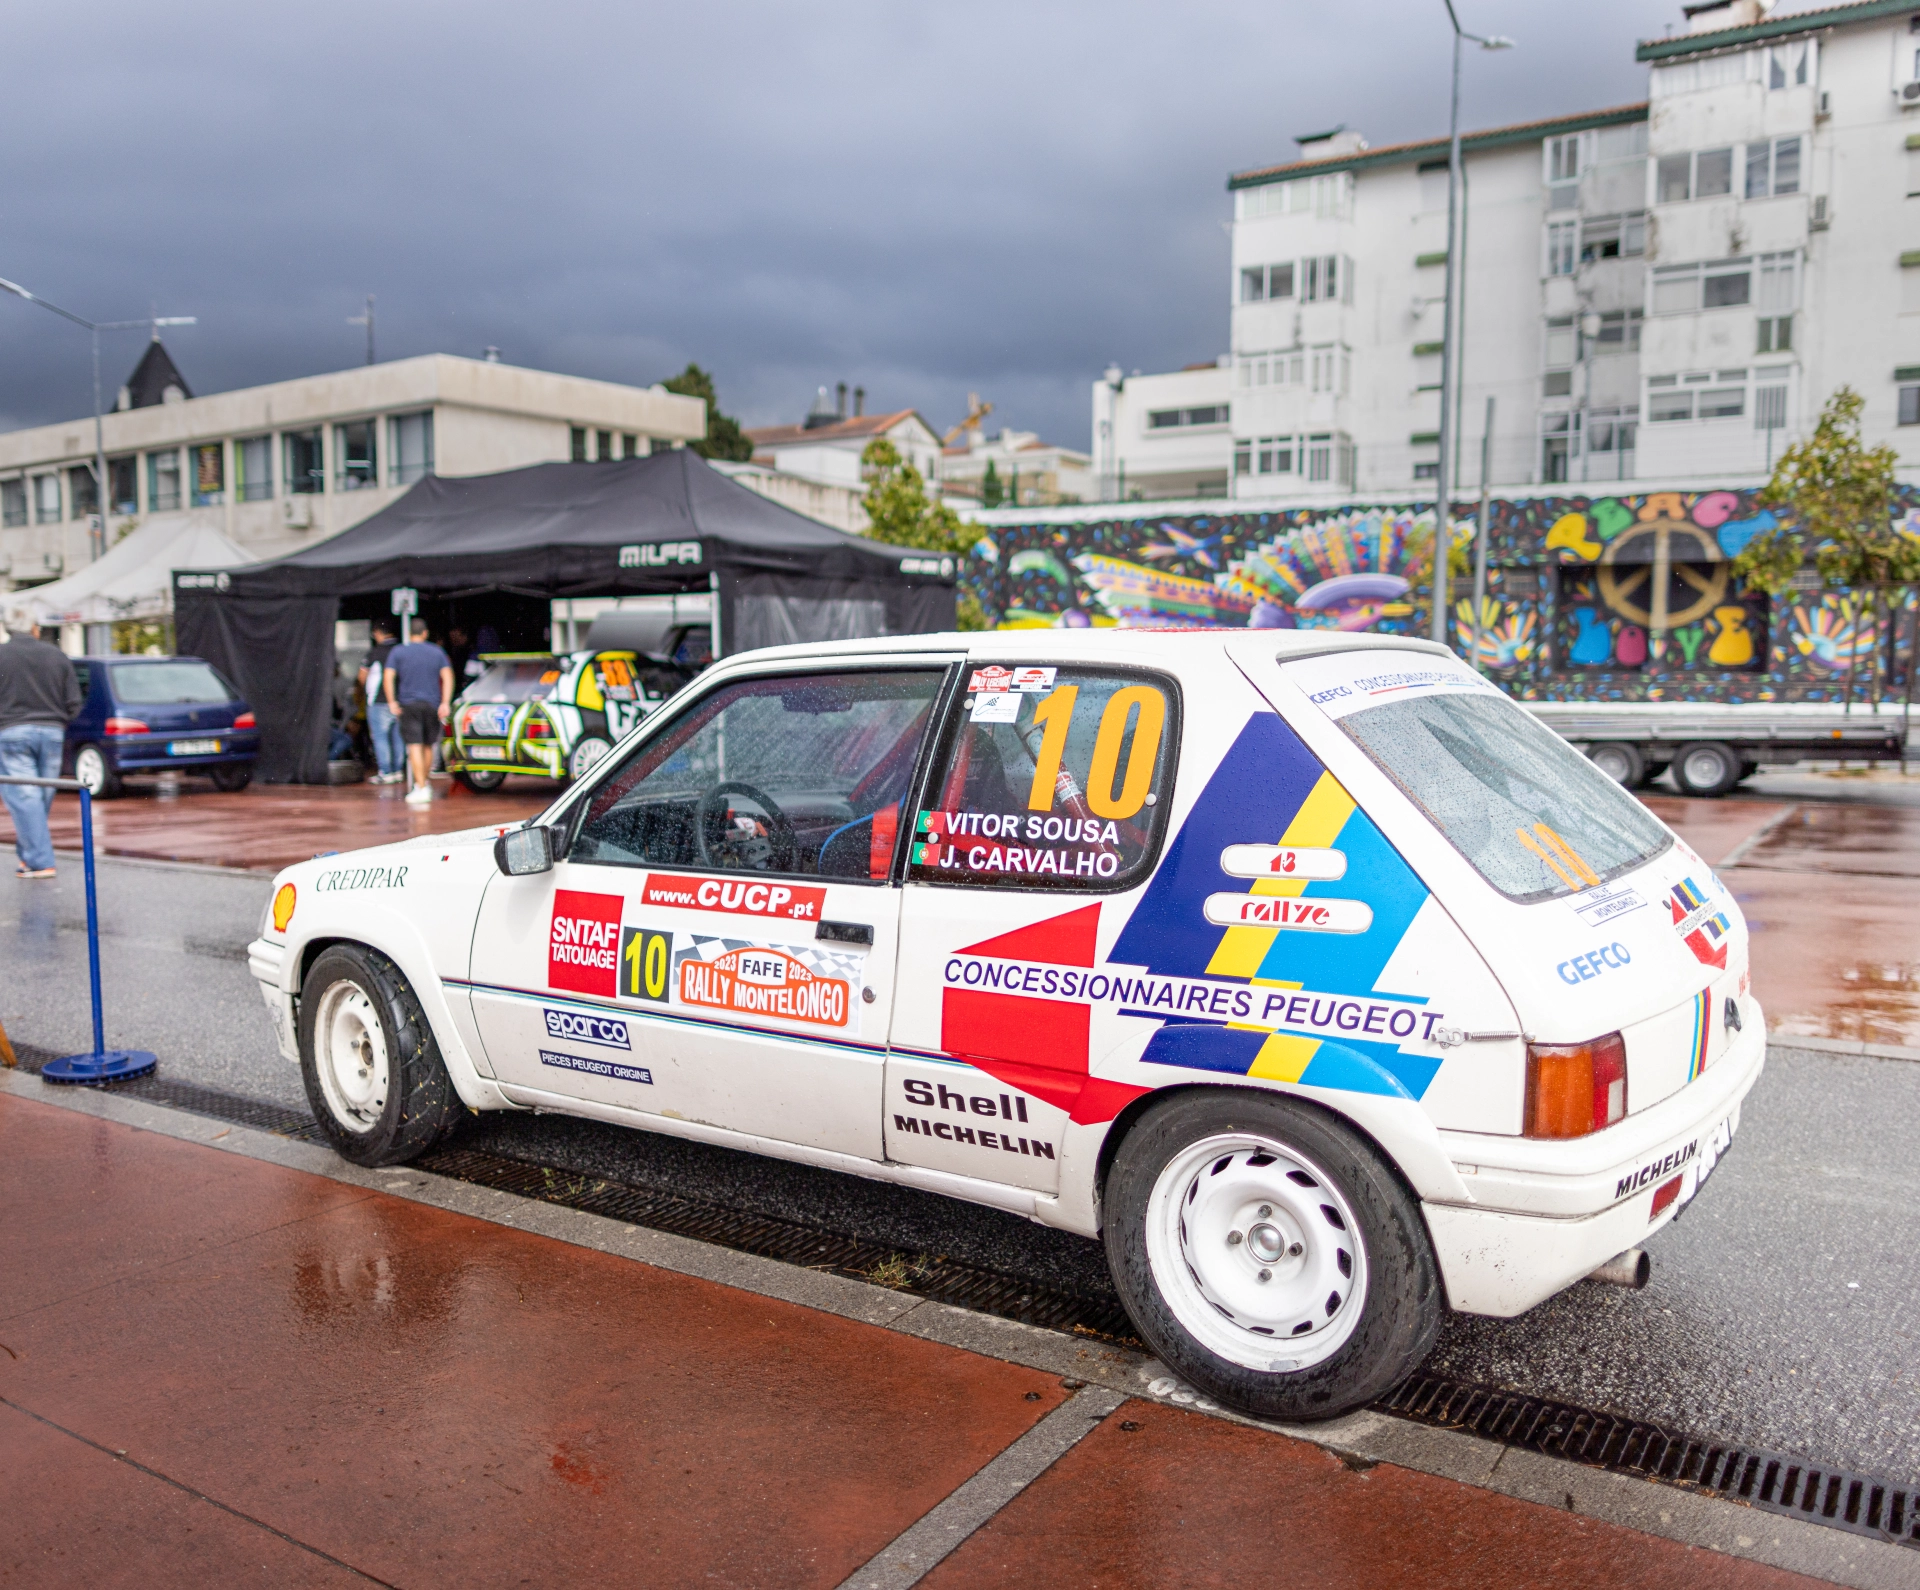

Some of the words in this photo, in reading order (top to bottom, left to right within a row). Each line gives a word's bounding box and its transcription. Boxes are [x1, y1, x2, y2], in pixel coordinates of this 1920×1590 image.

[619, 541, 702, 568] MILFA
[1569, 605, 1754, 666] LOVE
[1310, 686, 1353, 704] GEFCO
[1028, 685, 1165, 820] 10
[945, 812, 1019, 838] VITOR
[1026, 816, 1120, 844] SOUSA
[940, 846, 961, 869] J.
[968, 846, 1118, 876] CARVALHO
[1515, 823, 1601, 892] 10
[316, 866, 409, 892] CREDIPAR
[649, 880, 814, 919] www.CUCP.pt
[1240, 901, 1330, 925] rallye
[552, 916, 619, 948] SNTAF
[551, 943, 616, 970] TATOUAGE
[625, 932, 667, 998] 10
[714, 954, 737, 972] 2023
[742, 958, 783, 979] FAFE
[789, 962, 813, 982] 2023
[1556, 942, 1631, 985] GEFCO
[685, 964, 730, 1005] RALLY
[734, 982, 844, 1022] MONTELONGO
[944, 959, 1253, 1017] CONCESSIONNAIRES
[1261, 993, 1444, 1040] PEUGEOT
[547, 1011, 628, 1042] sparco
[542, 1052, 572, 1067] PIECES
[572, 1059, 612, 1075] PEUGEOT
[613, 1066, 650, 1082] ORIGINE
[903, 1079, 1028, 1123] Shell
[893, 1114, 1055, 1160] MICHELIN
[1615, 1139, 1698, 1199] MICHELIN
